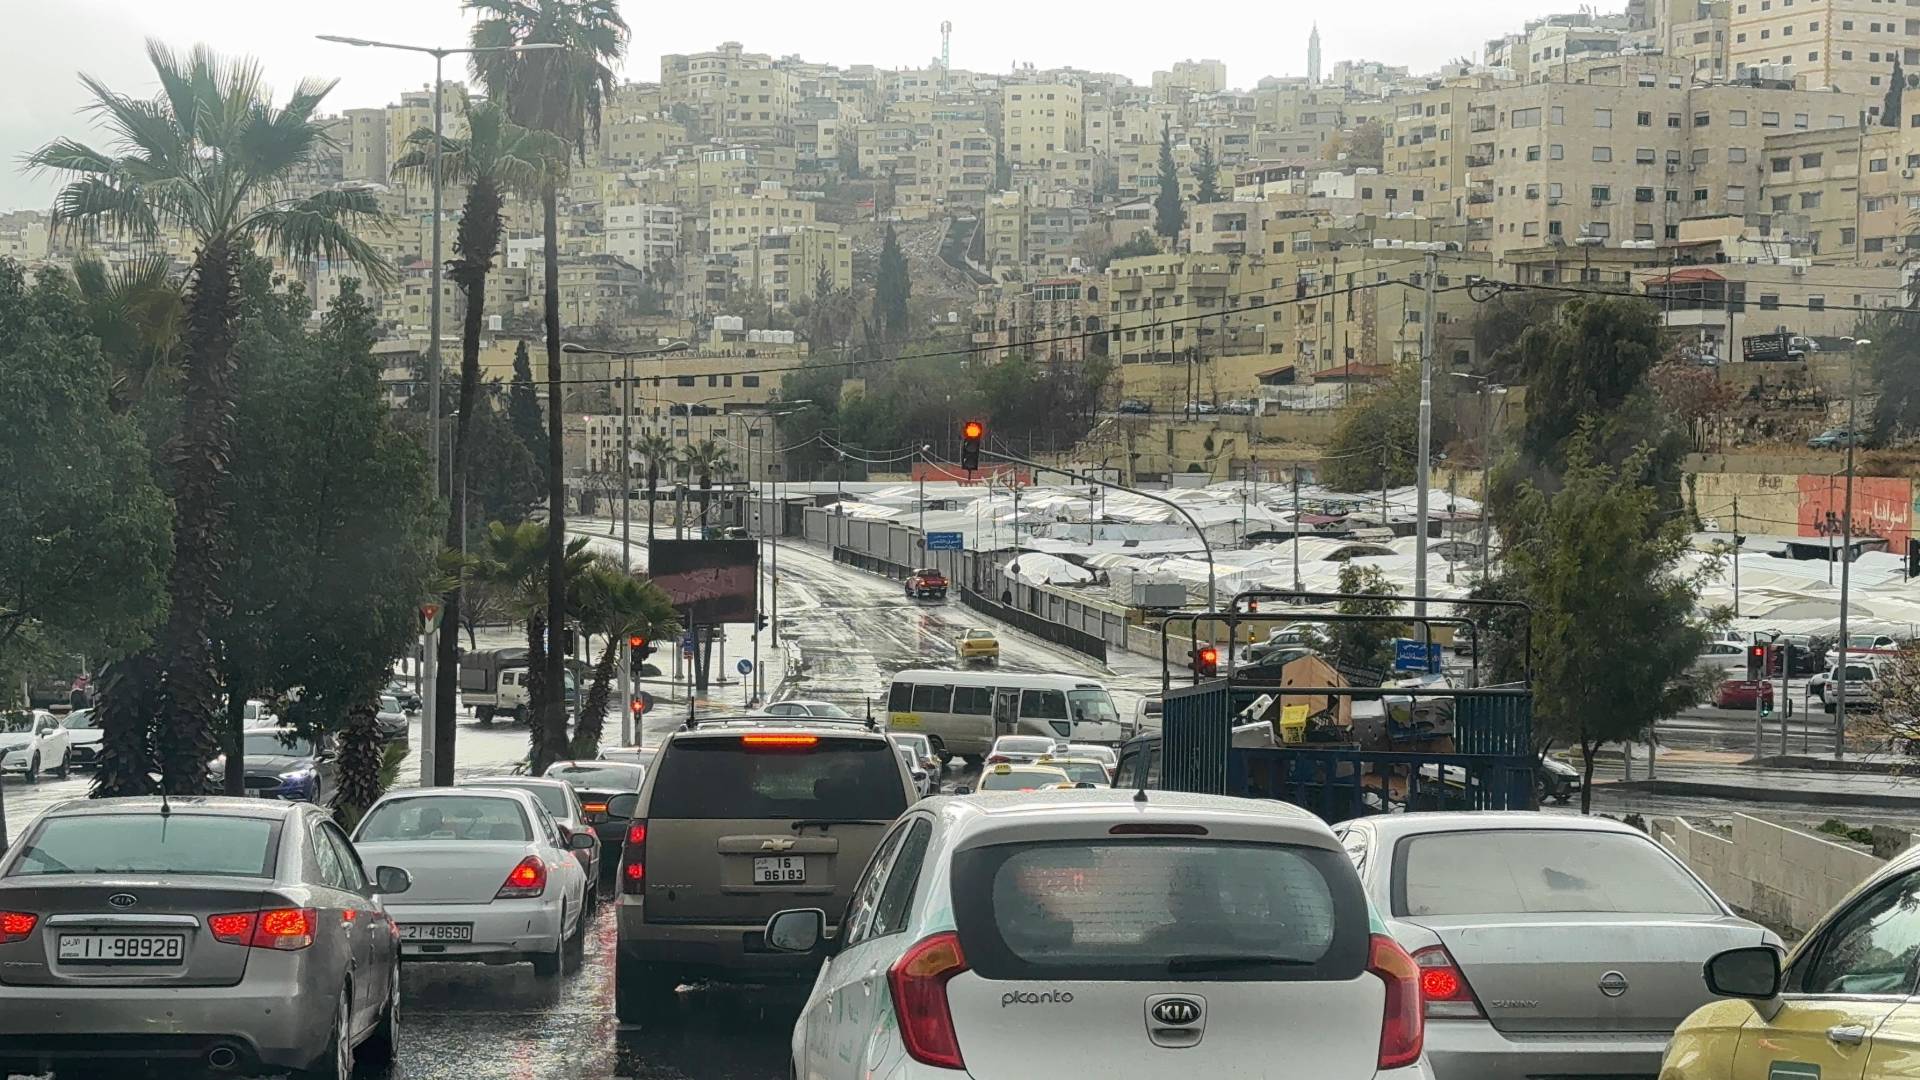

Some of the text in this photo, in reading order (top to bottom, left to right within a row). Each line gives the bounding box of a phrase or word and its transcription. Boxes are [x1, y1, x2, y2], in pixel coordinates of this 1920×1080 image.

[778, 858, 791, 869] 16
[764, 869, 803, 880] 86183
[1002, 989, 1074, 1008] picanto
[1161, 1005, 1194, 1020] KIA
